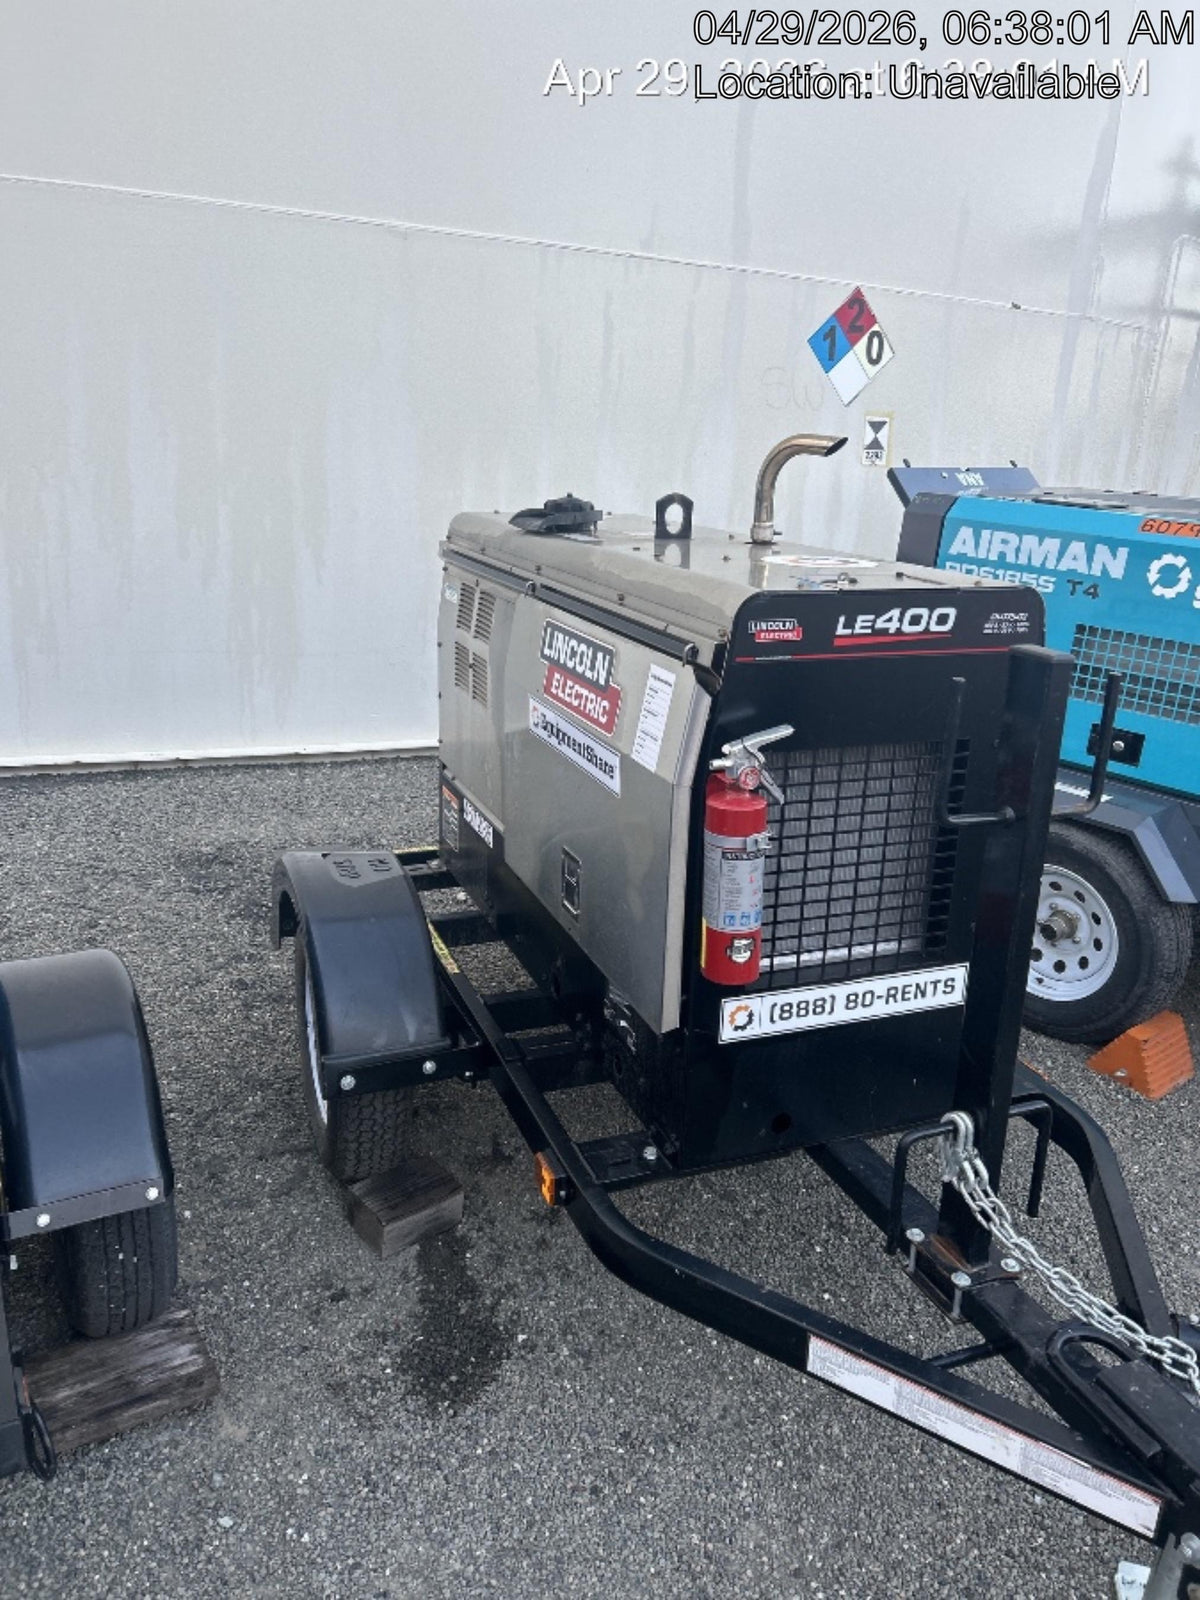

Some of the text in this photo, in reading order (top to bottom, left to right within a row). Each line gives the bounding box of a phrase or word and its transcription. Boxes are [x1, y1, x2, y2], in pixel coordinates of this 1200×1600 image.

[847, 299, 867, 334] 2
[822, 325, 837, 362] 1
[865, 330, 885, 366] 0
[948, 526, 1129, 579] AIRMAN
[751, 621, 794, 631] LINCOLN
[835, 607, 957, 636] LE400
[543, 627, 611, 687] LINCOLN
[550, 671, 611, 724] ELECTRIC
[768, 976, 957, 1025] (888) 80-RENTS
